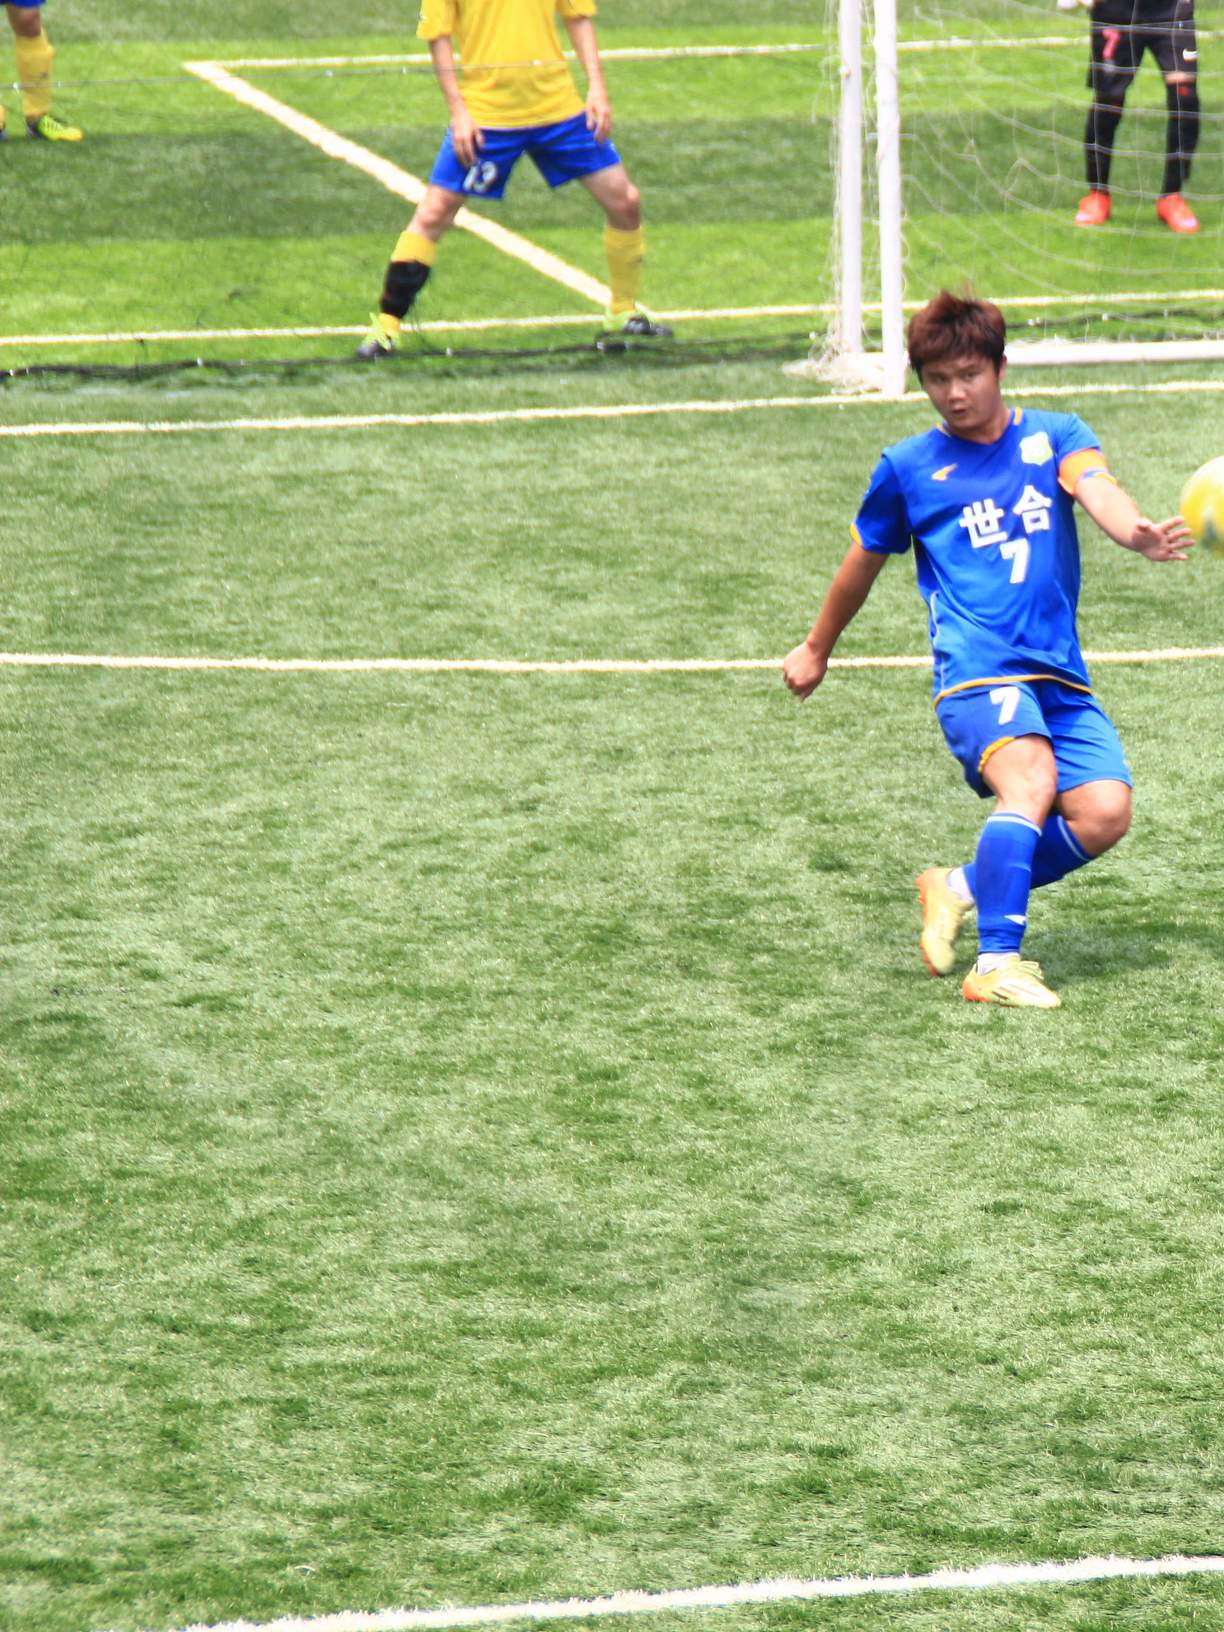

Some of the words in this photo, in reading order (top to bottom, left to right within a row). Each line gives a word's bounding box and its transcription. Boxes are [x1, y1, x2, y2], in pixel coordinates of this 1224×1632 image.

[959, 485, 1052, 548] 世合
[1000, 538, 1029, 584] 7
[990, 686, 1020, 725] 7
